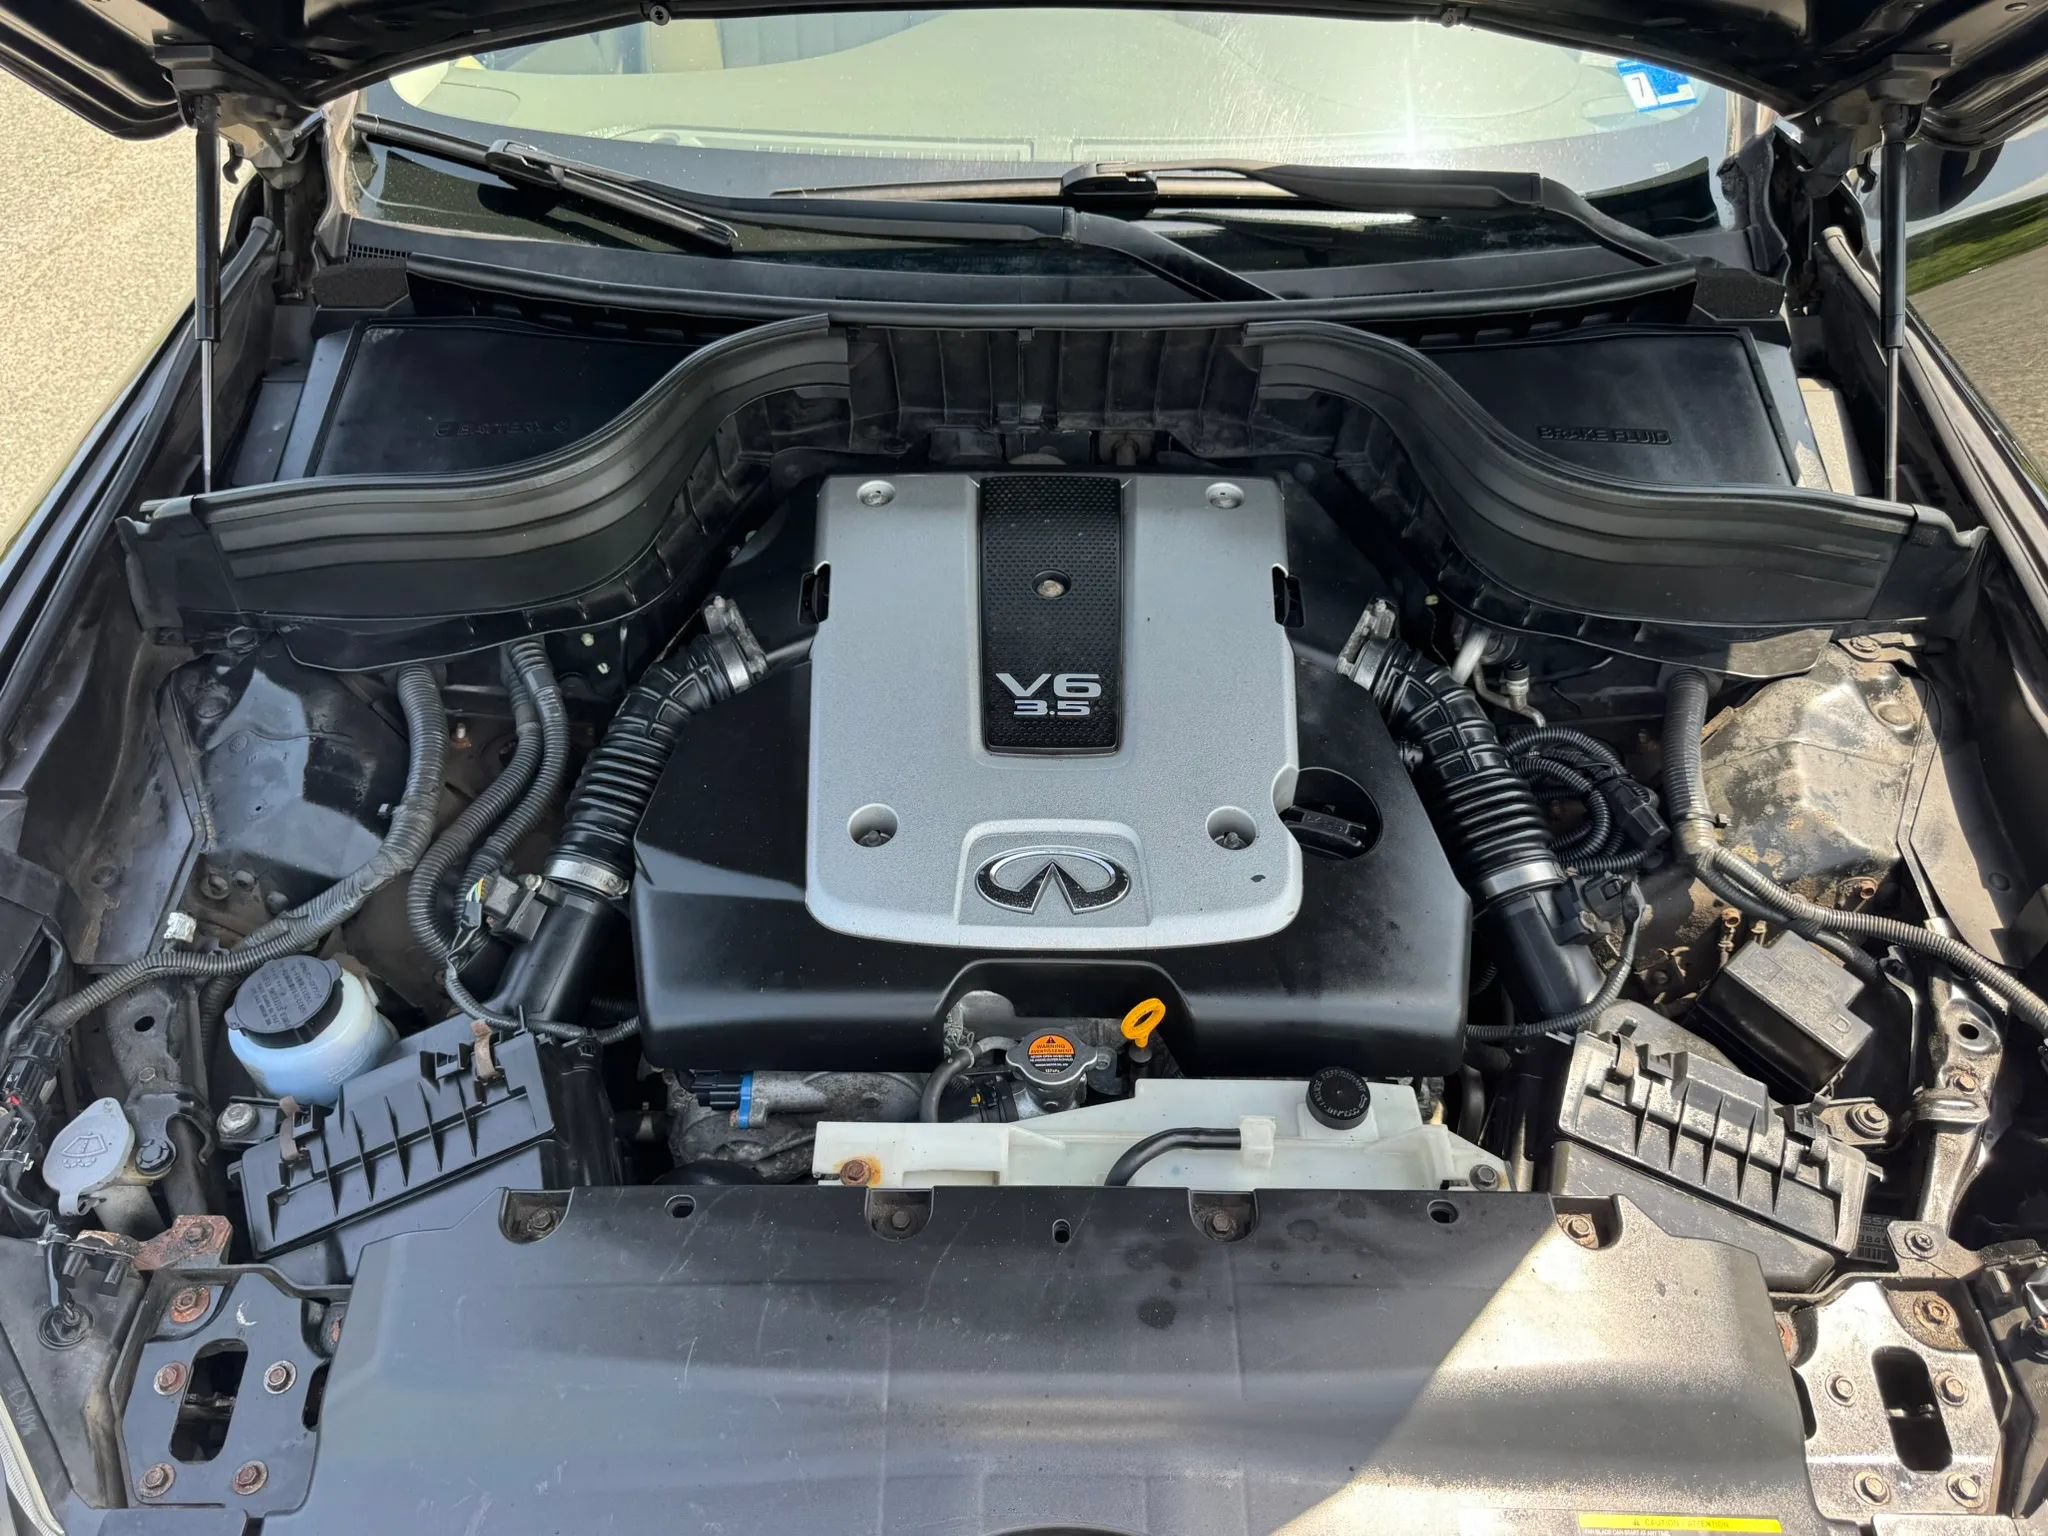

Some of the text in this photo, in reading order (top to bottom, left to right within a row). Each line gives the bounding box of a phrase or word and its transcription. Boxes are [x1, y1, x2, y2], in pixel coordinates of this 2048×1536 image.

[1539, 427, 1671, 444] BRAKE FLUID
[995, 673, 1102, 698] V6
[1013, 699, 1090, 716] 3.5
